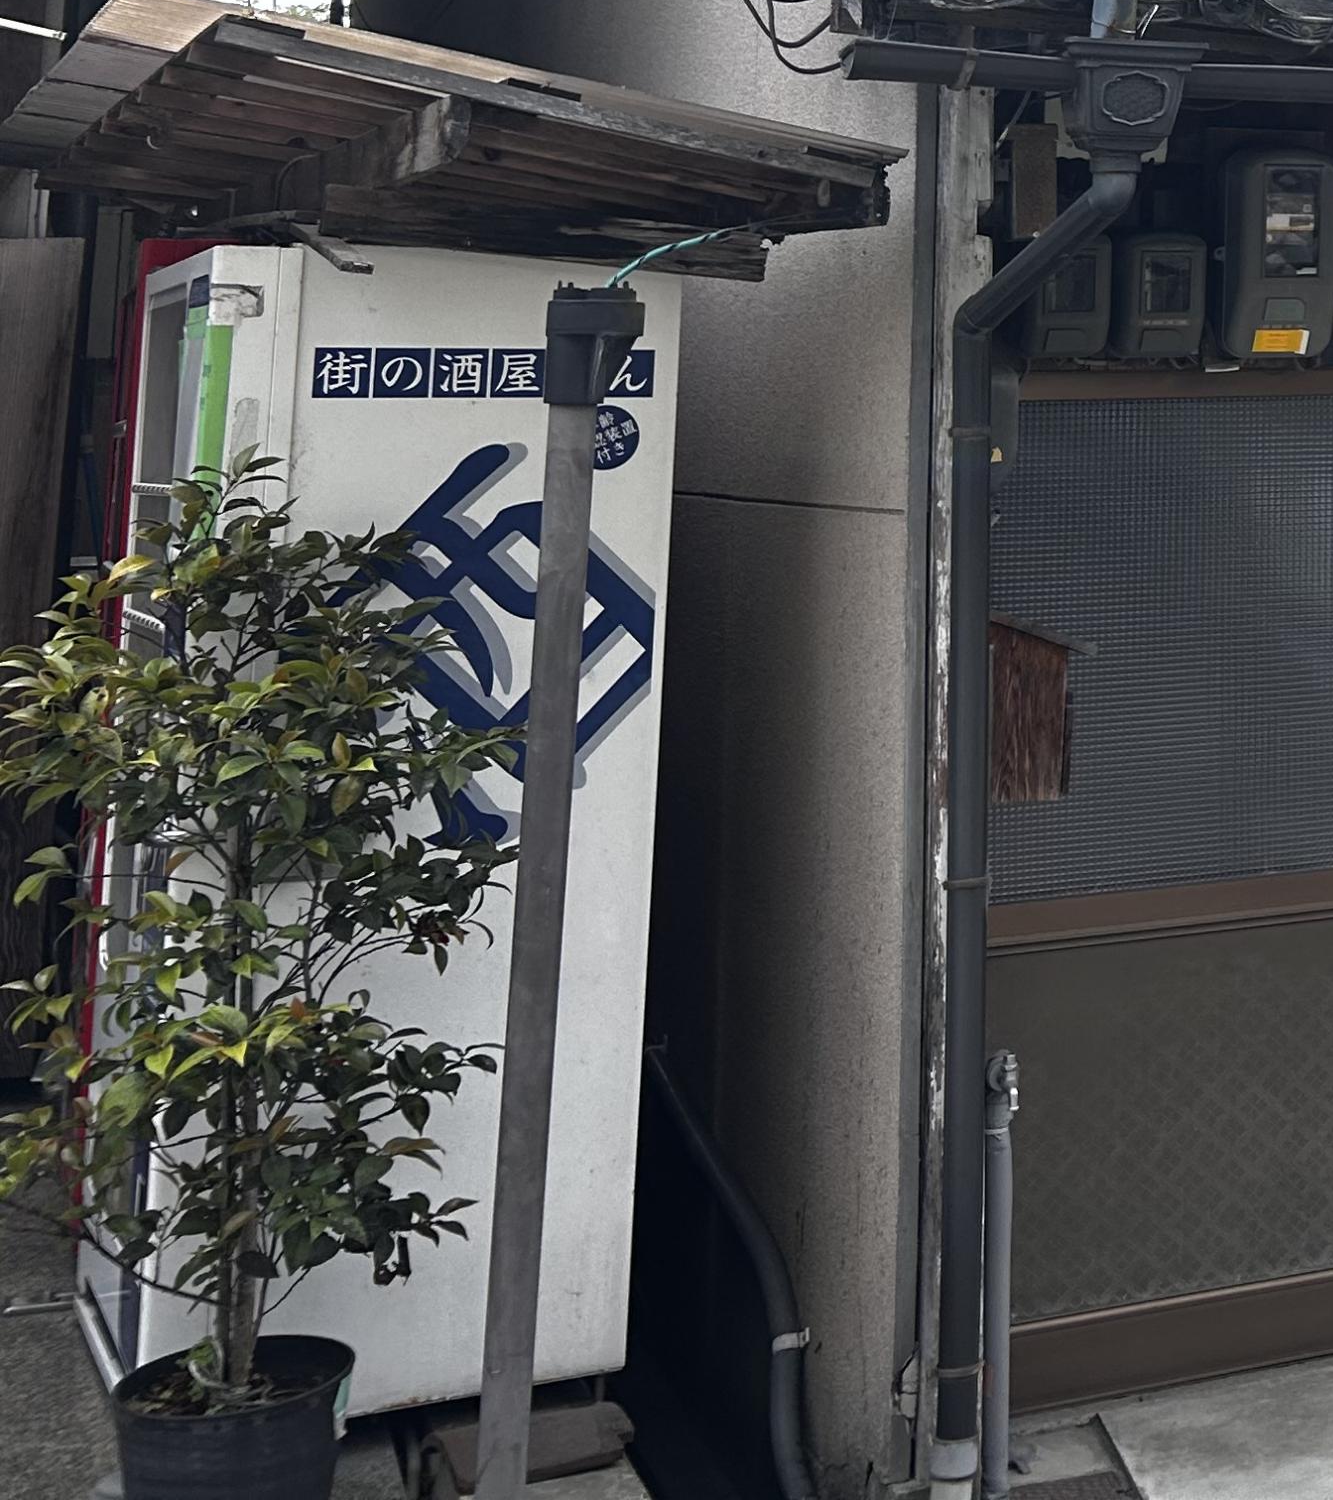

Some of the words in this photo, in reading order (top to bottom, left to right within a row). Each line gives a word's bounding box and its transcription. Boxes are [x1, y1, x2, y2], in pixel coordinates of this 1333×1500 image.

[316, 351, 648, 395] 街の酒屋ん
